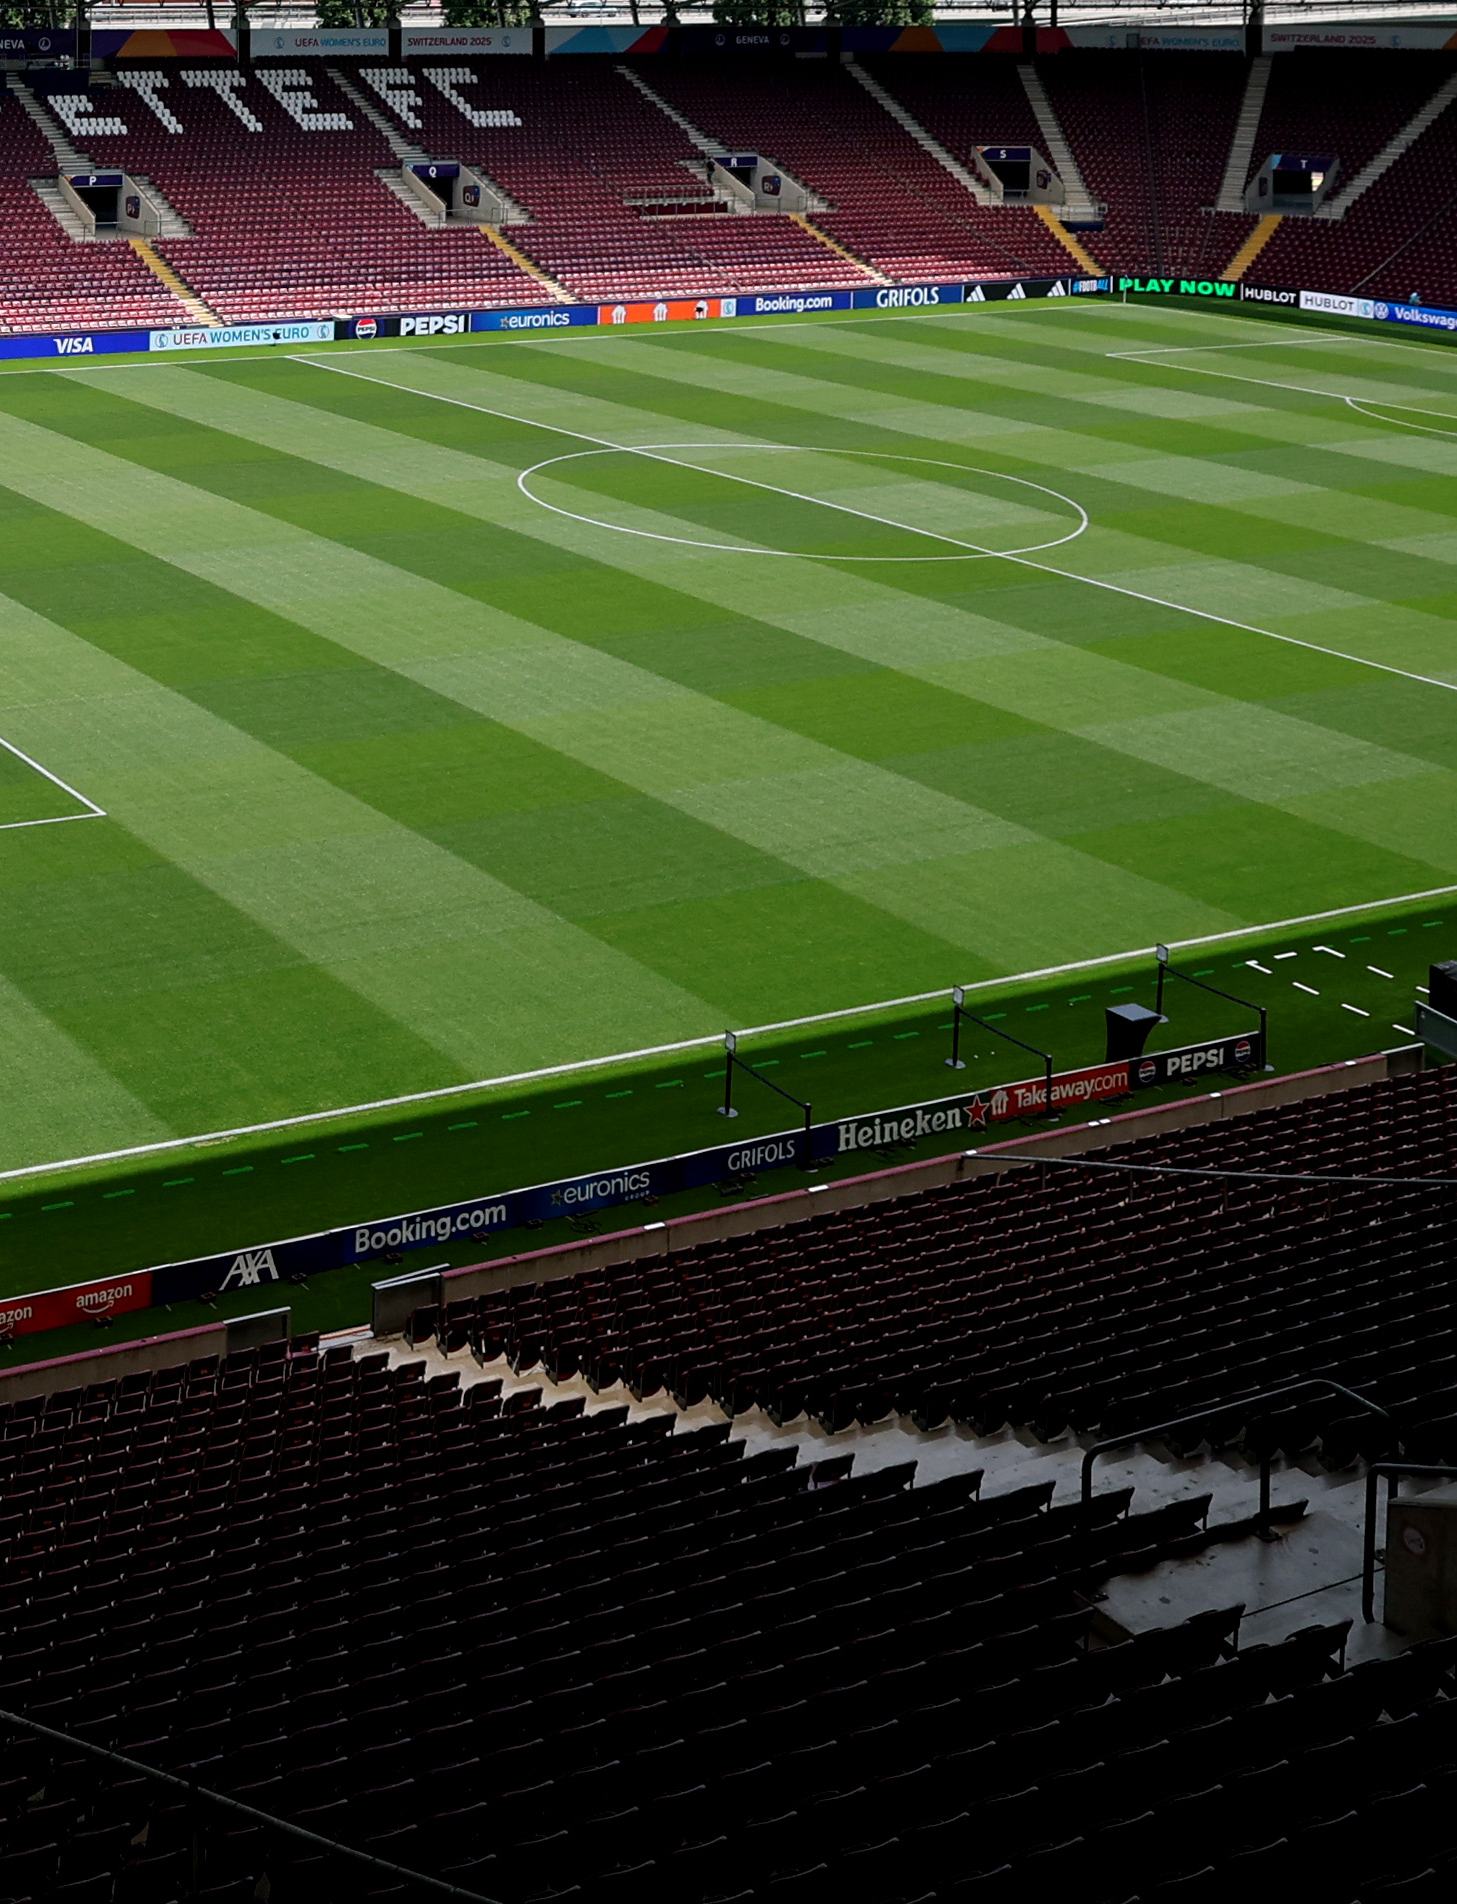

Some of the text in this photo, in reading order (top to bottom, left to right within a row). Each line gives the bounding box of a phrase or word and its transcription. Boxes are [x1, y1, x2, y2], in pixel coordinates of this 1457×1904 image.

[295, 38, 387, 48] UEFA WOMEN'S EURO
[407, 37, 492, 47] SWITZERLAND 2025
[735, 36, 770, 45] GENEVA
[1140, 37, 1160, 46] EFA
[1271, 33, 1377, 44] SWITZERLAND 2025
[731, 158, 737, 166] R
[999, 150, 1007, 159] S
[429, 166, 437, 178] Q
[1300, 160, 1308, 168] T
[89, 176, 97, 186] P
[1073, 278, 1109, 294] #FOOTBALL
[1119, 277, 1236, 298] PLAY NOW
[755, 292, 833, 312] Booking.com
[876, 288, 939, 308] GRIFOLS
[1245, 287, 1297, 304] HUBLOT
[1305, 295, 1355, 312] HUBLOT
[400, 316, 466, 336] PEPSI
[509, 310, 570, 328] euronics
[173, 334, 207, 346] UEFA
[210, 328, 271, 344] WOMEN'S
[53, 338, 94, 355] VISA
[1166, 1048, 1225, 1078] PEPSI
[1014, 1070, 1129, 1109] Takeaway.com
[837, 1106, 963, 1152] Heineken
[727, 1140, 796, 1172] GRIFOLS
[563, 1171, 651, 1205] euronics
[625, 1190, 651, 1201] GROUP
[355, 1204, 507, 1254] Booking.com
[218, 1249, 279, 1292] AXA
[75, 1283, 133, 1309] amazon
